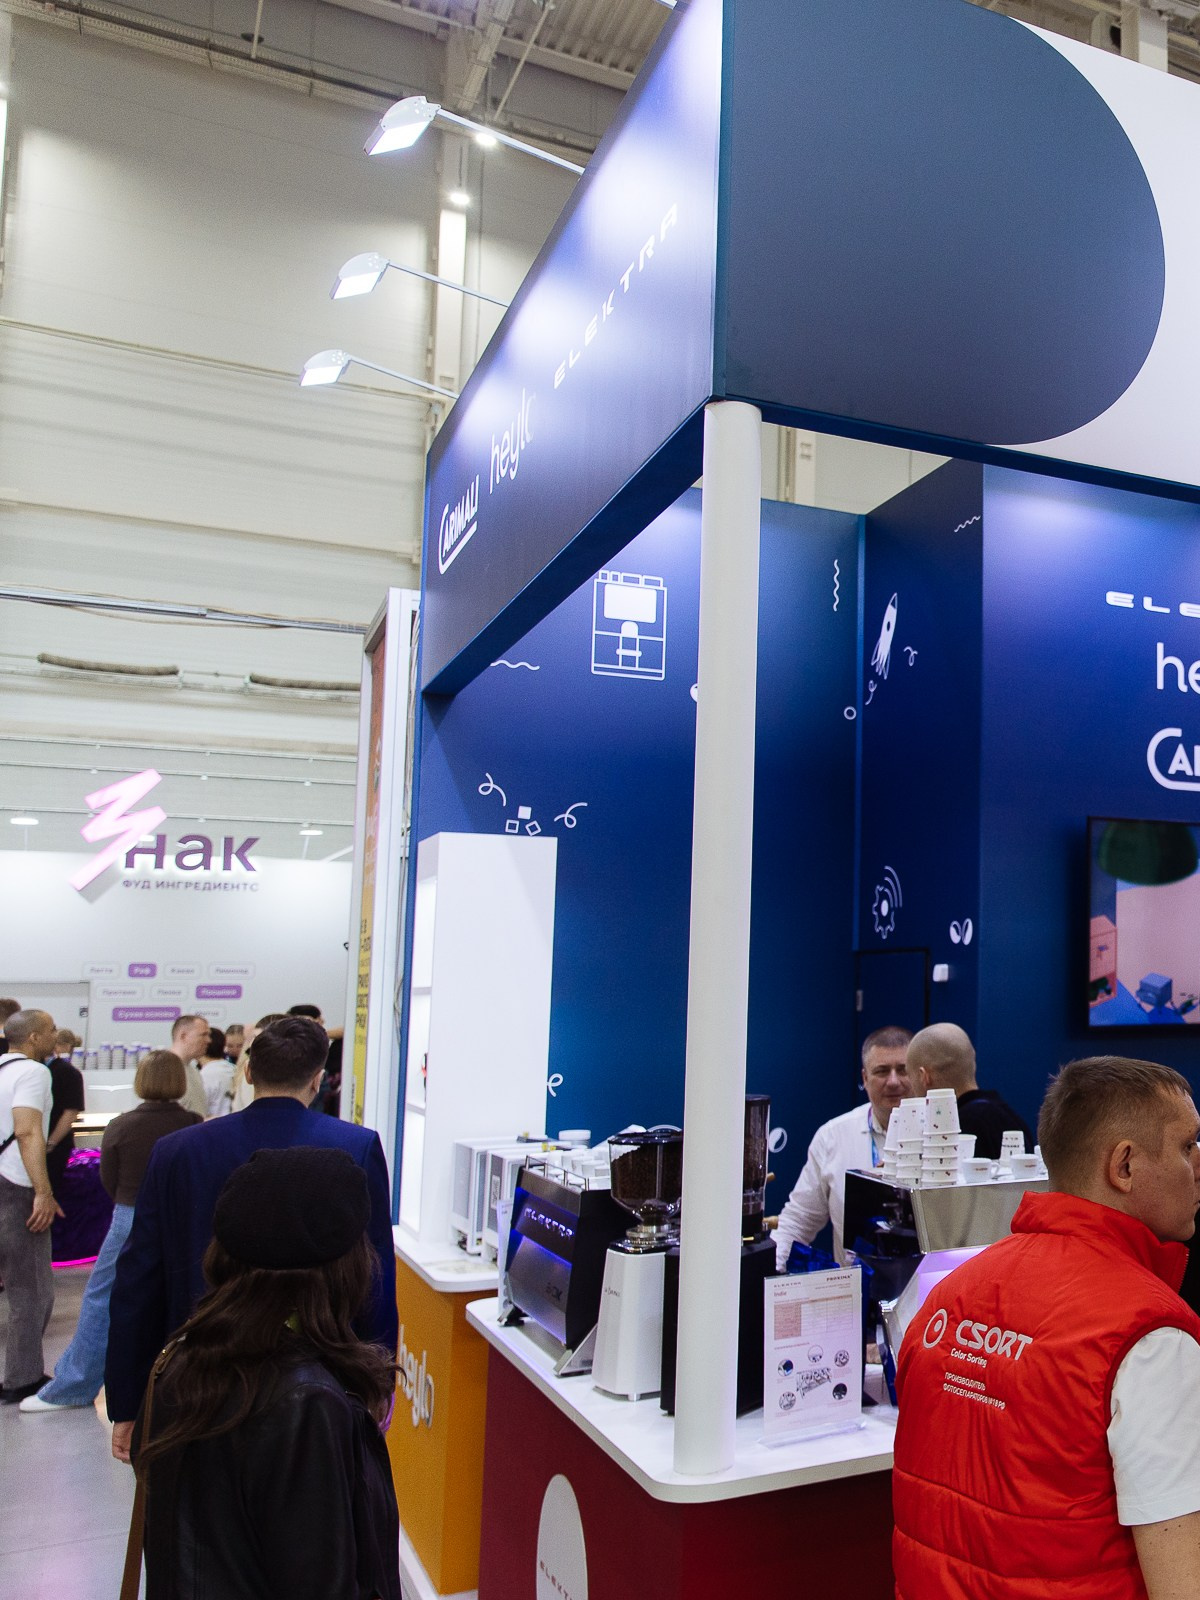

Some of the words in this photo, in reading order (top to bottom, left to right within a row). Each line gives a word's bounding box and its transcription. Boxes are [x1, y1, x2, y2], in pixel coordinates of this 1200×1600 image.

[554, 204, 678, 389] ELEKTRA
[438, 475, 479, 575] CARIMALI
[950, 1347, 967, 1360] Color
[966, 1352, 988, 1369] Sorting
[955, 1319, 1034, 1361] CSORT
[944, 1371, 986, 1391] ПРОИЗВОДИТЕЛЬ
[539, 1559, 573, 1600] ELEKT
